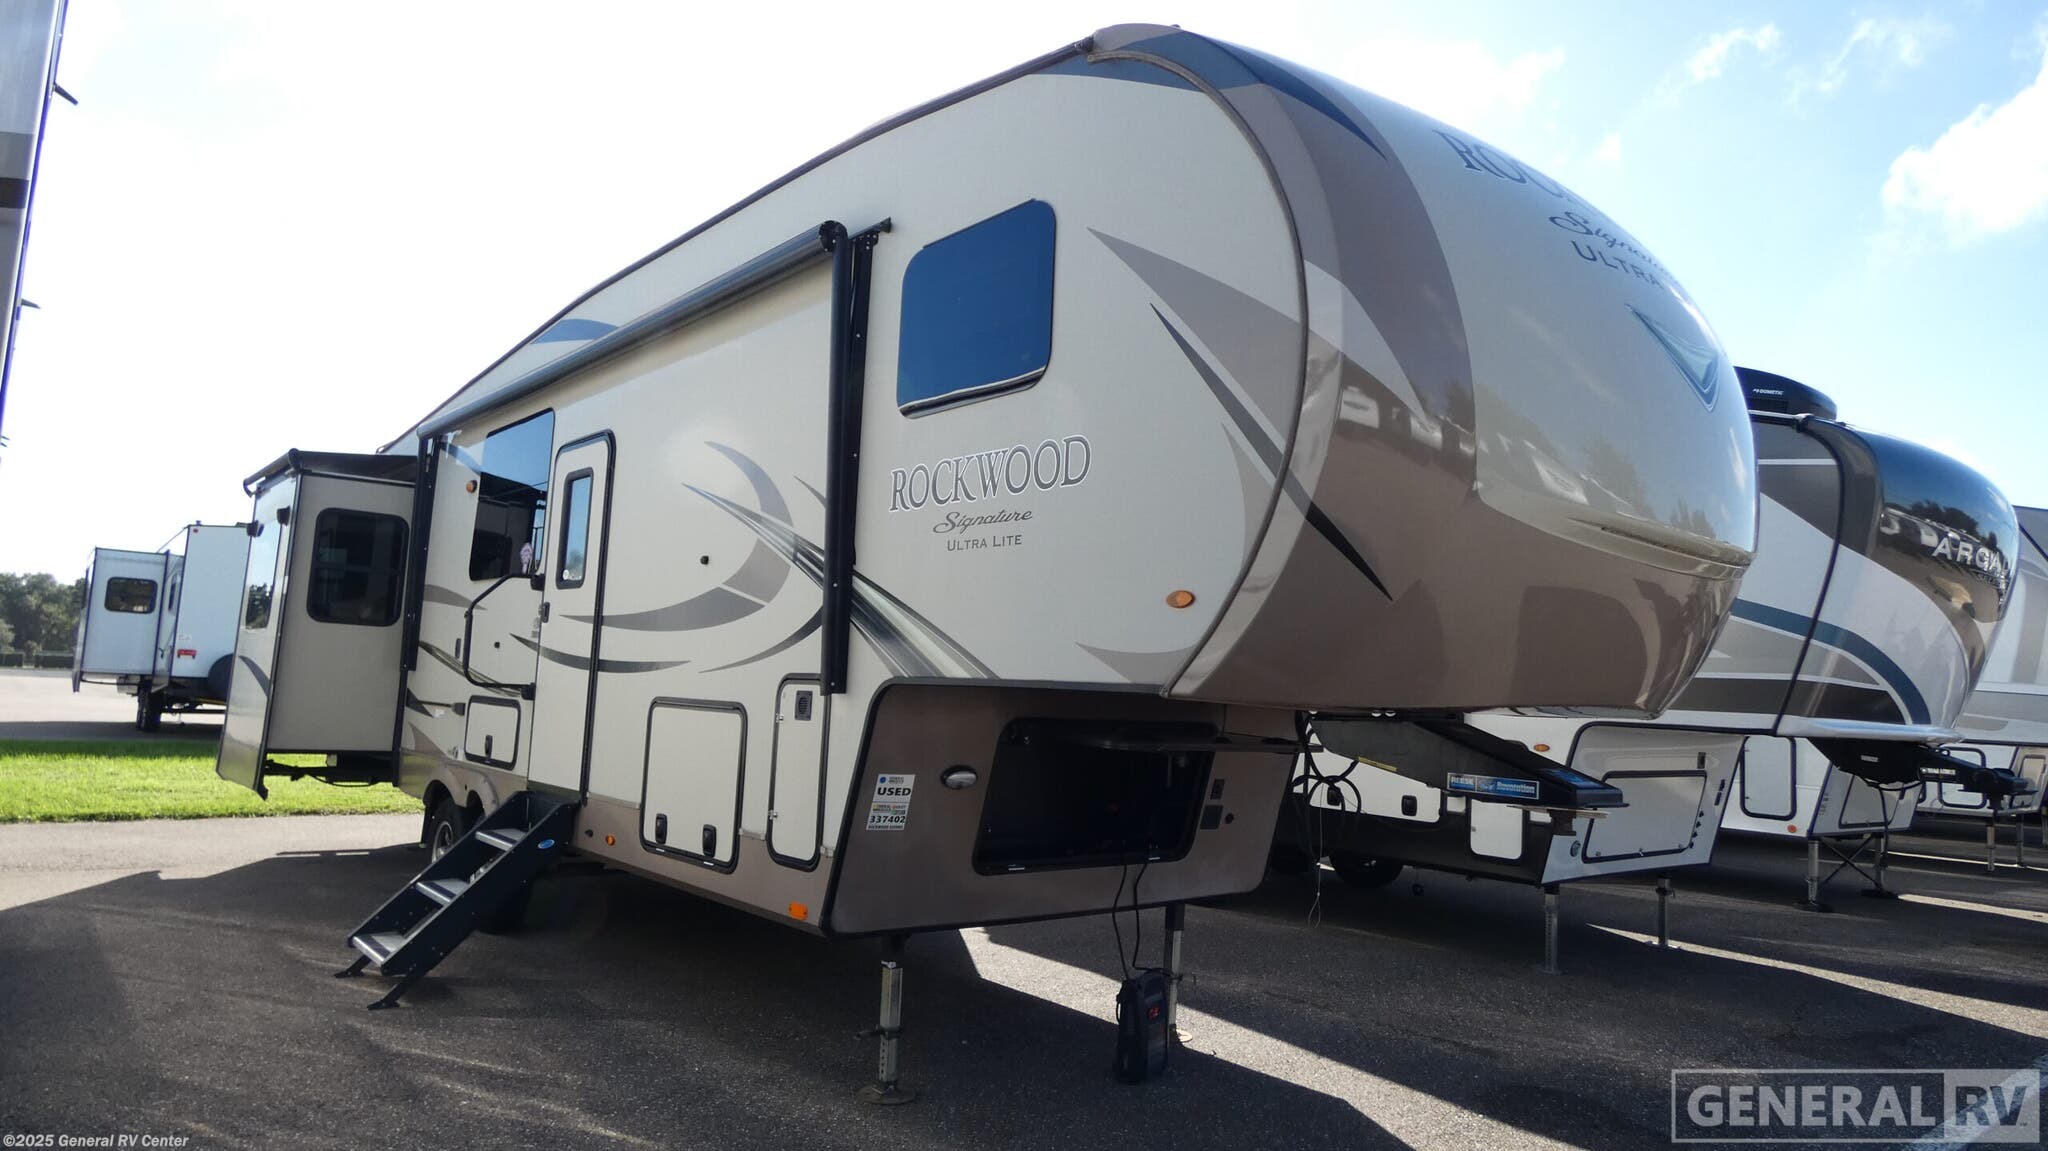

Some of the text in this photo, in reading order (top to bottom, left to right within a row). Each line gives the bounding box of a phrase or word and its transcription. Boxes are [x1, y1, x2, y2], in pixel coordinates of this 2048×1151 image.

[889, 435, 1091, 512] ROCKWOOD
[933, 509, 1033, 534] Signature
[947, 535, 1022, 551] ULTRA LITE
[877, 787, 911, 796] USED
[869, 815, 906, 823] 337402
